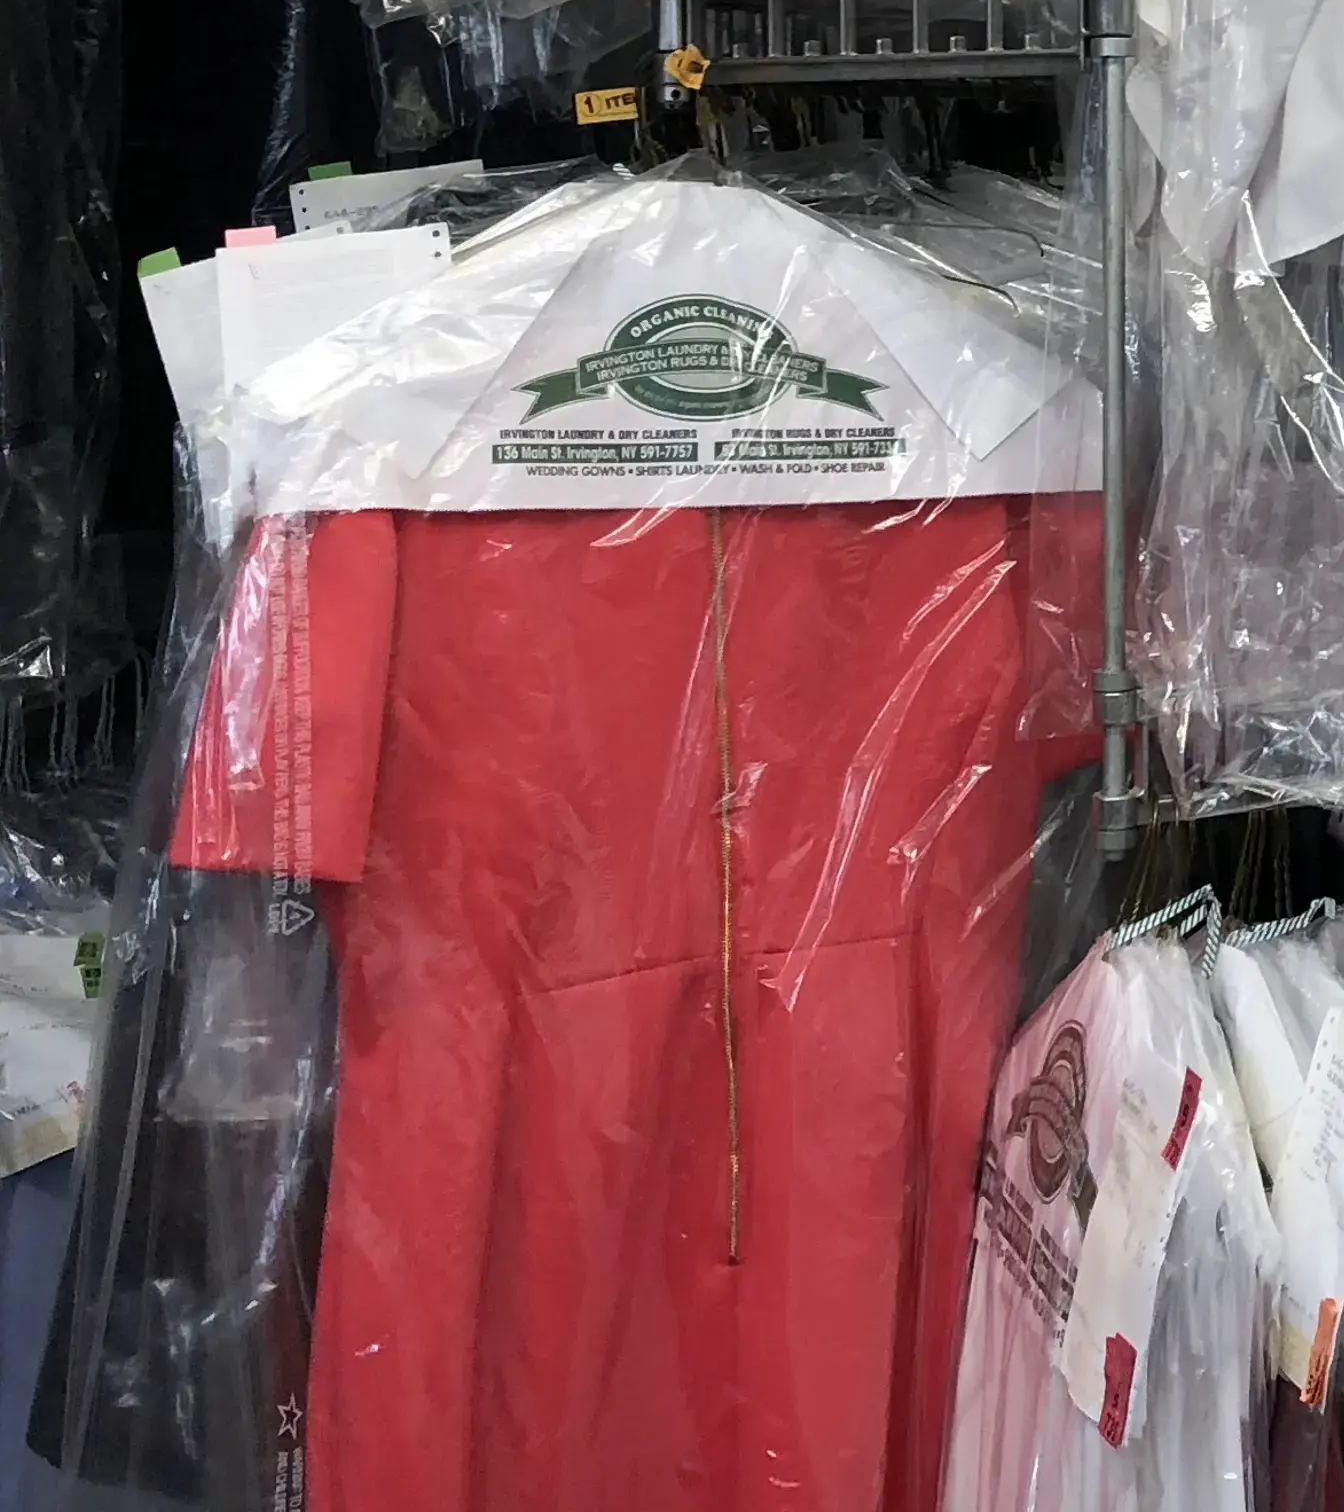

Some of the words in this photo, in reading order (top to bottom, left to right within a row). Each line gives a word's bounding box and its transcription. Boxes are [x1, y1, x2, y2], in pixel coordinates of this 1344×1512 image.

[630, 305, 700, 338] ORGANIC
[586, 349, 656, 372] IRVINGTON
[657, 345, 717, 358] LAUNDRY
[597, 358, 667, 381] IRVINGTON
[670, 356, 707, 368] RUGS
[500, 429, 555, 440] IRVINGTON
[558, 429, 605, 440] LAUNDRY
[618, 429, 639, 440] DRY
[641, 429, 697, 439] CLEANERS
[846, 427, 895, 437] CLEANERS
[497, 446, 519, 460] 136
[521, 445, 549, 459] Main
[550, 445, 563, 460] St.
[566, 445, 619, 463] Irvington,
[621, 445, 637, 458] NY
[640, 444, 693, 458] 591-7757
[834, 442, 848, 456] NY
[526, 465, 579, 477] WEDDING
[582, 466, 626, 476] GOWNS
[635, 464, 672, 476] SHIRTS
[739, 464, 773, 474] WASH
[787, 464, 812, 474] FOLD
[821, 462, 848, 473] SHOE
[851, 461, 886, 473] REPAIR
